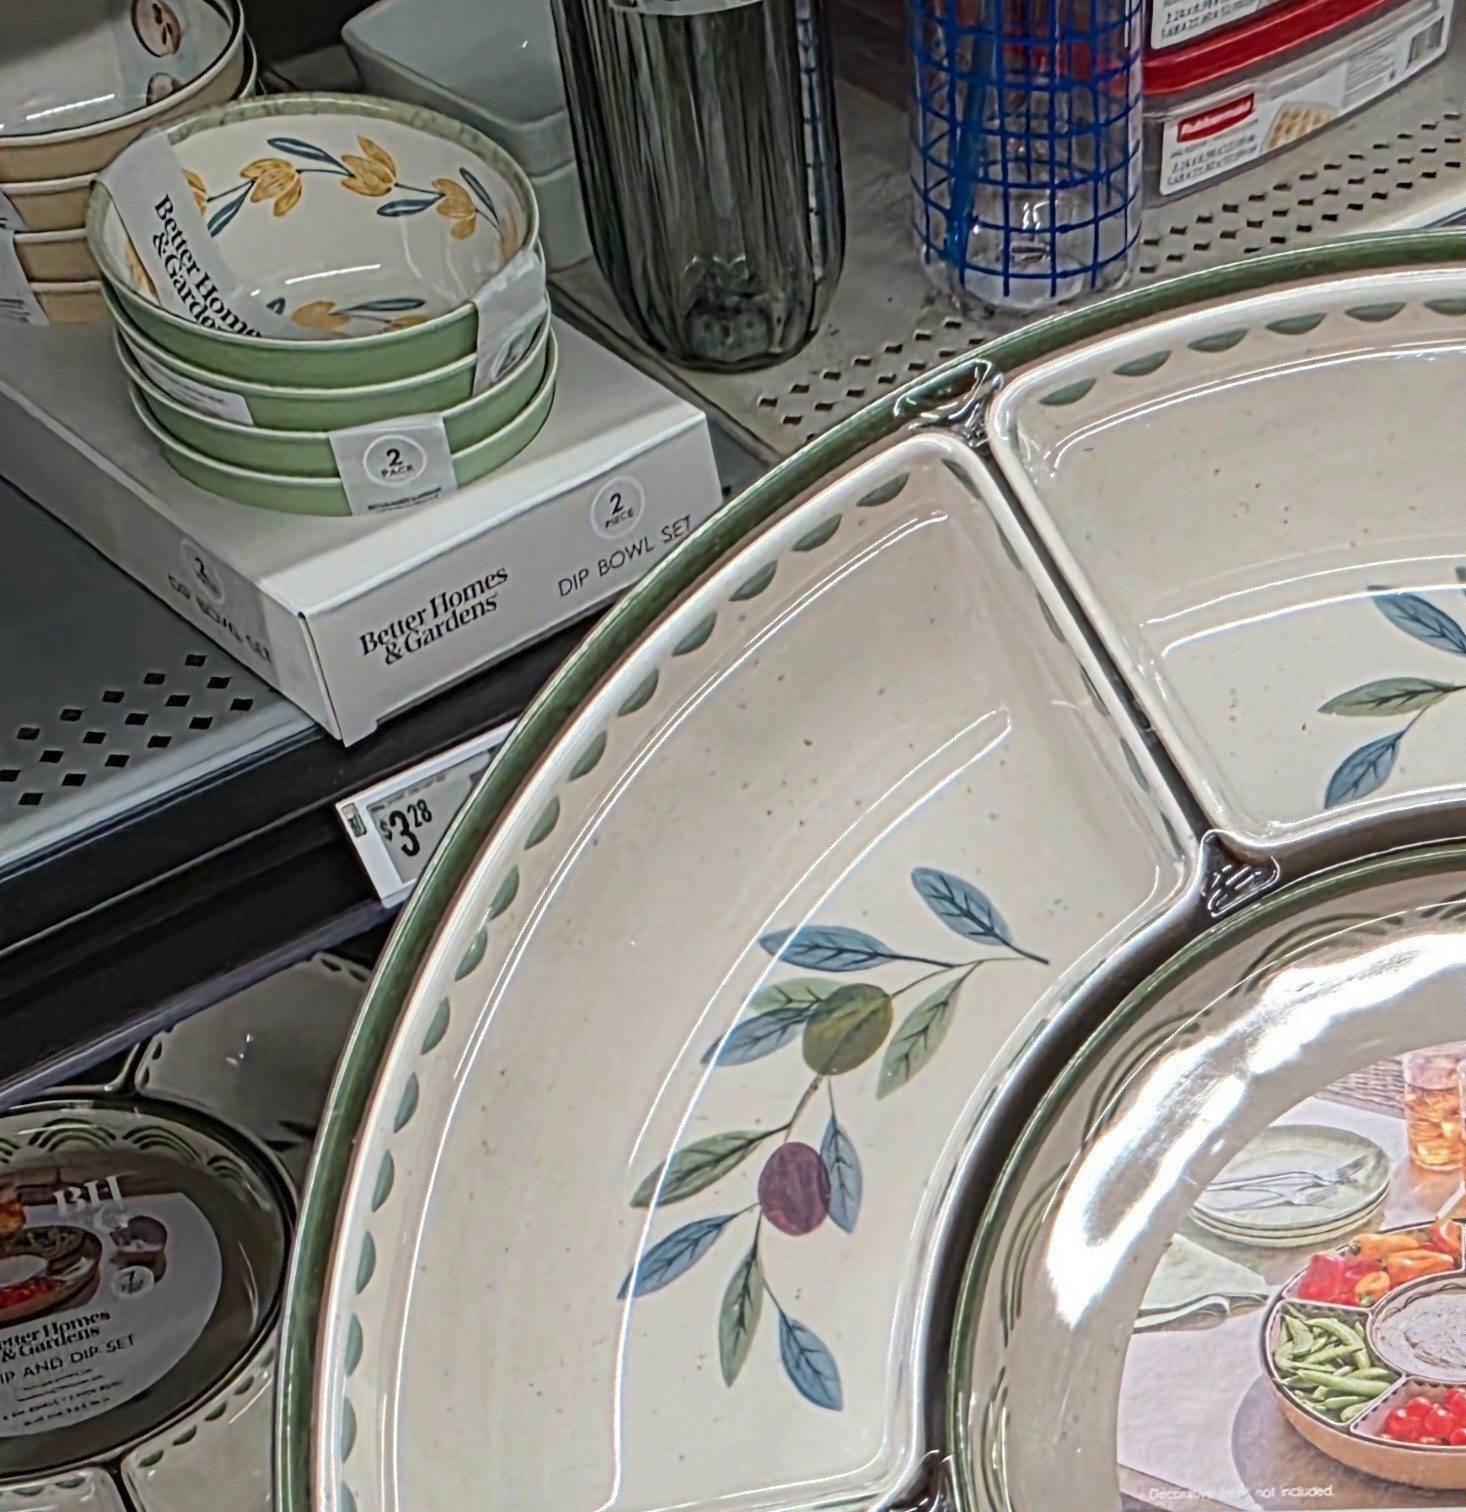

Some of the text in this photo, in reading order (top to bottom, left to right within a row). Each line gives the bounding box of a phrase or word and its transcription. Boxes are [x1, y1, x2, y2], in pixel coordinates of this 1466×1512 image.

[155, 193, 200, 276] Better
[386, 448, 403, 467] 2
[609, 493, 624, 515] 2
[558, 514, 690, 597] DIP BOWL SET
[359, 567, 508, 656] Better Homes
[23, 1358, 63, 1378] AND
[70, 1346, 99, 1363] DIP
